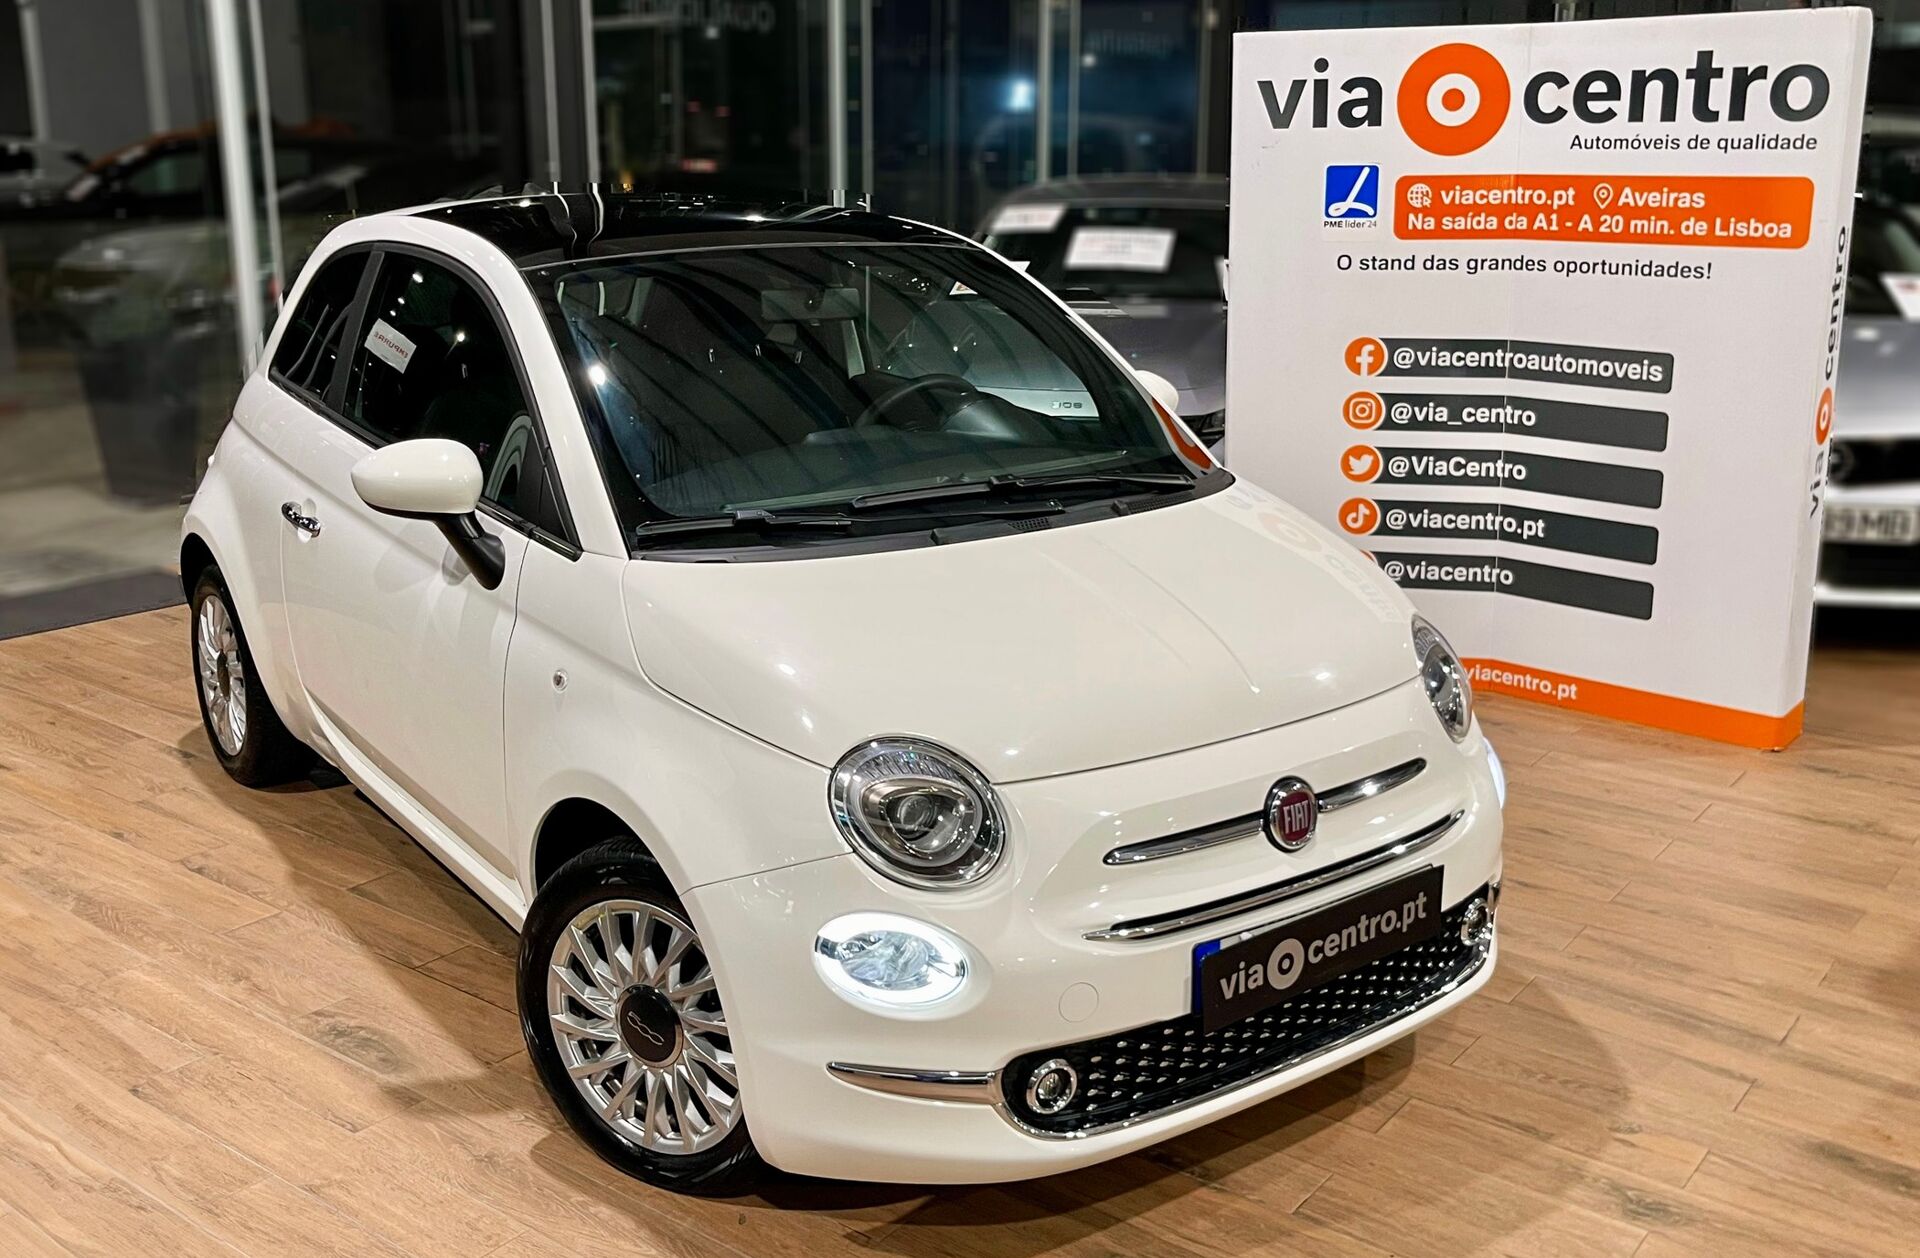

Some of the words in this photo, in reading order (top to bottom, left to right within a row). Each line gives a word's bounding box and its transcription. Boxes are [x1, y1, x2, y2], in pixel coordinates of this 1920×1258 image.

[1257, 57, 1383, 130] via
[1523, 50, 1831, 125] centro
[1570, 134, 1681, 151] Automóveis
[1688, 133, 1711, 150] de
[1717, 133, 1818, 156] qualidade
[1440, 185, 1576, 210] viacentro.pt
[1618, 187, 1706, 209] Aveiras
[1323, 221, 1343, 229] PME
[1408, 213, 1435, 230] Na
[1441, 212, 1498, 230] saída
[1504, 214, 1528, 230] da
[1533, 213, 1559, 231] A1
[1577, 214, 1594, 232] A
[1599, 215, 1624, 233] 20
[1629, 216, 1675, 235] min.
[1680, 217, 1708, 236] de
[1714, 217, 1792, 238] Lisboa
[1337, 255, 1351, 270] O
[1359, 255, 1416, 271] stand
[1423, 255, 1459, 271] das
[1466, 255, 1547, 275] grandes
[1553, 259, 1713, 280] oportunidades!
[1825, 226, 1846, 380] centro
[1393, 346, 1663, 383] @viacentroautomoveis
[1391, 401, 1536, 427] @via_centro
[1388, 456, 1527, 481] @ViaCentro
[1385, 509, 1545, 540] @viacentro.pt
[1383, 560, 1513, 586] @viacentro
[1464, 664, 1578, 700] viacentro.pt
[1283, 800, 1311, 834] FIAT
[1219, 961, 1265, 1000] via
[1307, 891, 1428, 964] centro.pt
